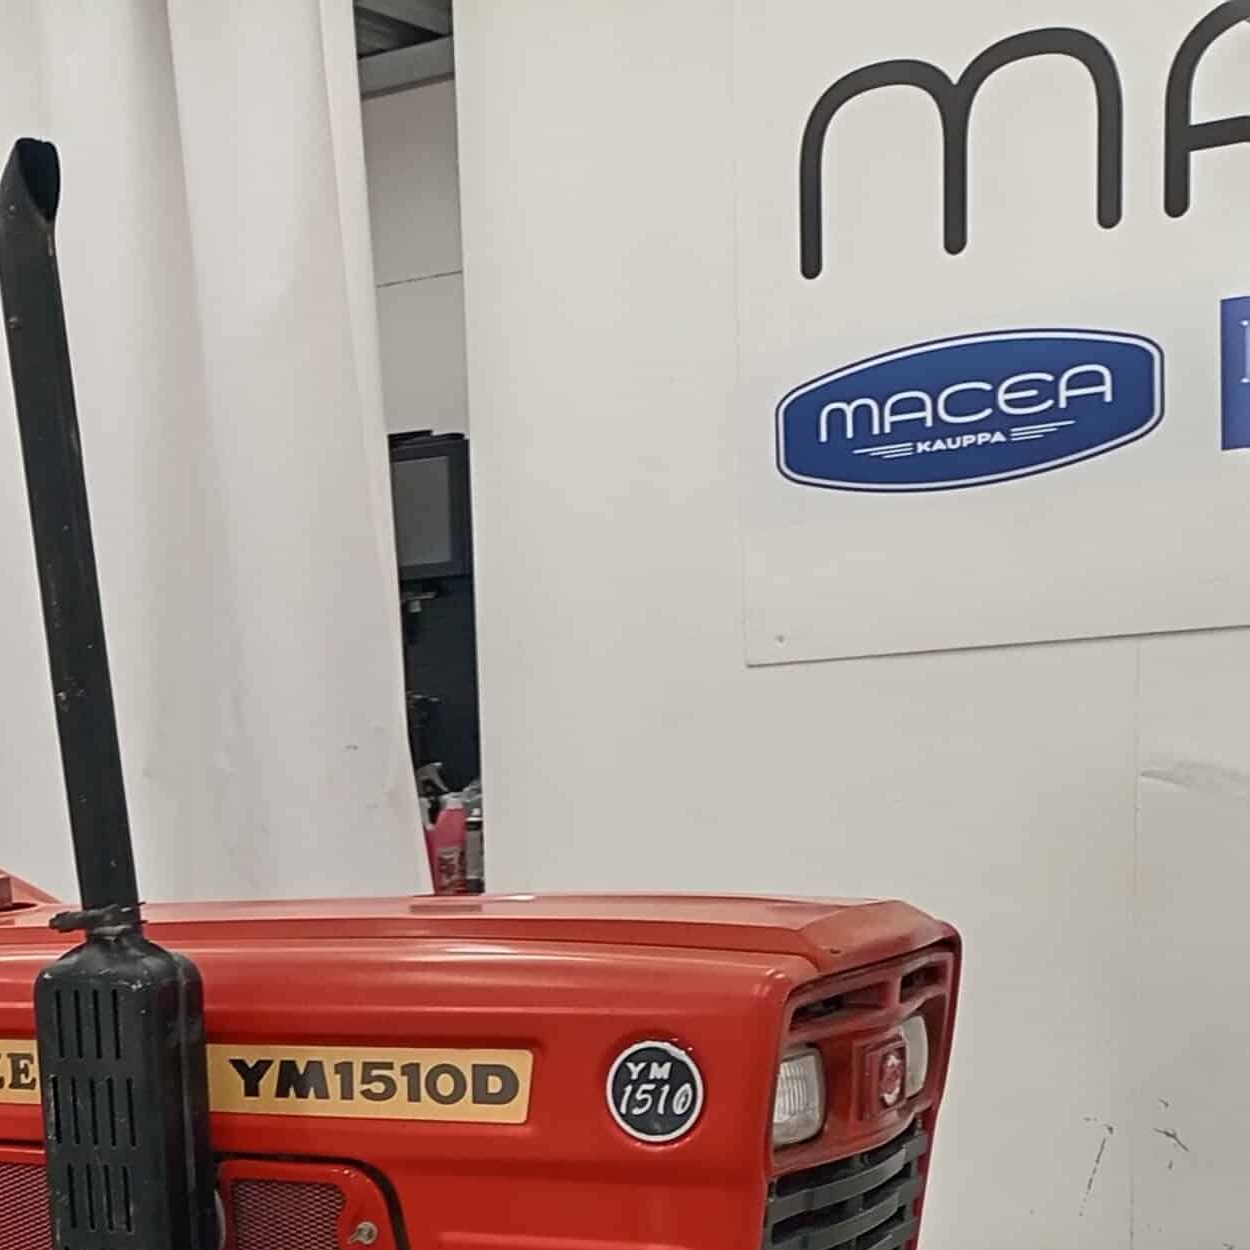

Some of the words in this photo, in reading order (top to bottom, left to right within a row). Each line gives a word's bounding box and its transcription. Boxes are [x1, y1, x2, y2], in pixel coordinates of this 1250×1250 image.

[819, 363, 1113, 443] MACEA
[915, 430, 1007, 454] KAUPPA
[228, 1058, 521, 1105] YM1510D
[625, 1061, 672, 1081] YM
[619, 1083, 693, 1116] 1510
